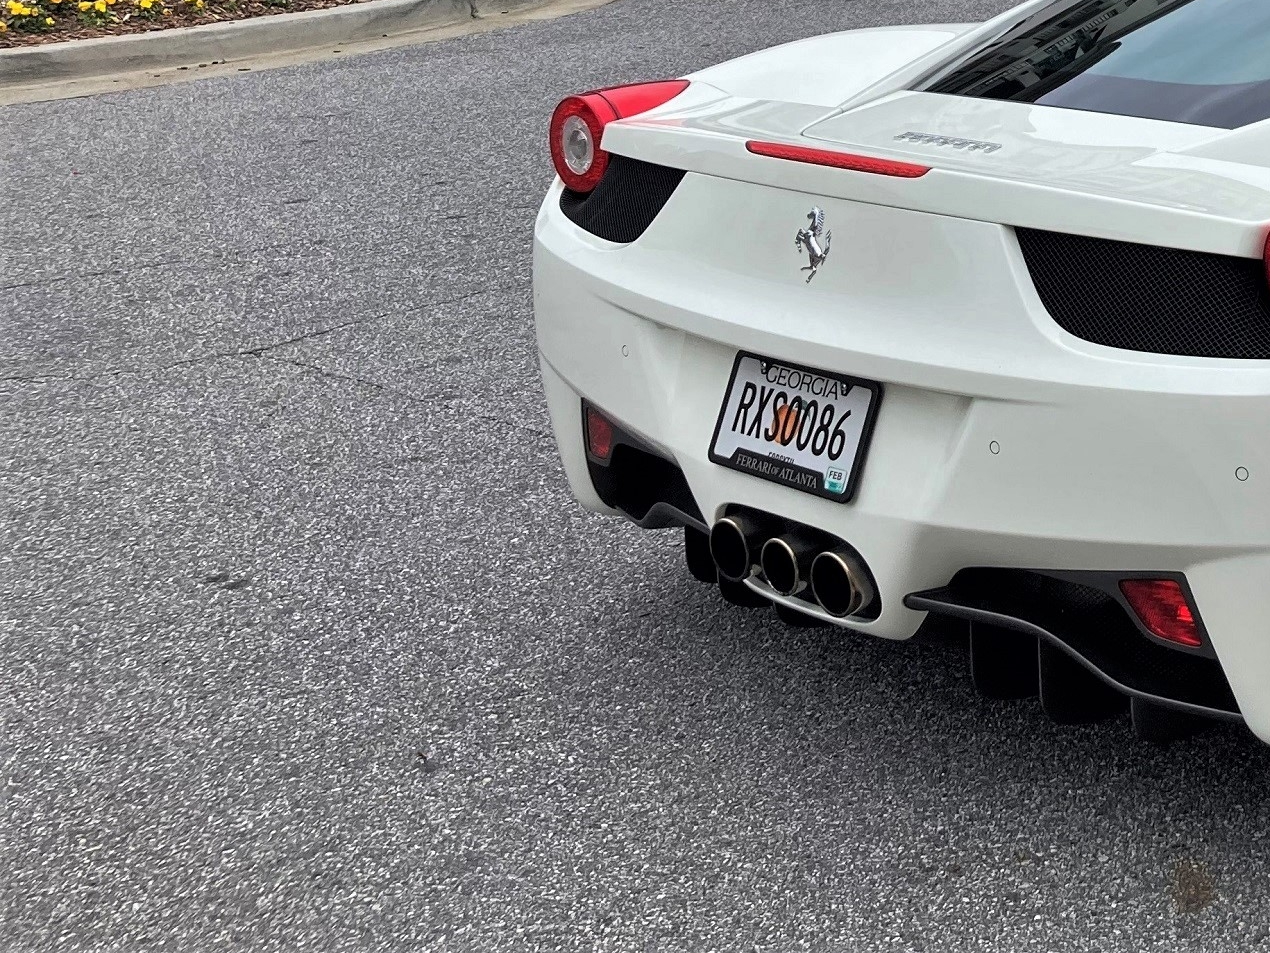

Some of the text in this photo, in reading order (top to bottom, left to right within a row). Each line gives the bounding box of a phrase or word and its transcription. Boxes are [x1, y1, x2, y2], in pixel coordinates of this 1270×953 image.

[765, 365, 839, 400] GEORGIA
[731, 381, 852, 461] RXS0086
[736, 453, 773, 475] FERRARI
[778, 469, 818, 489] ATLANTA
[828, 470, 843, 481] FEB
